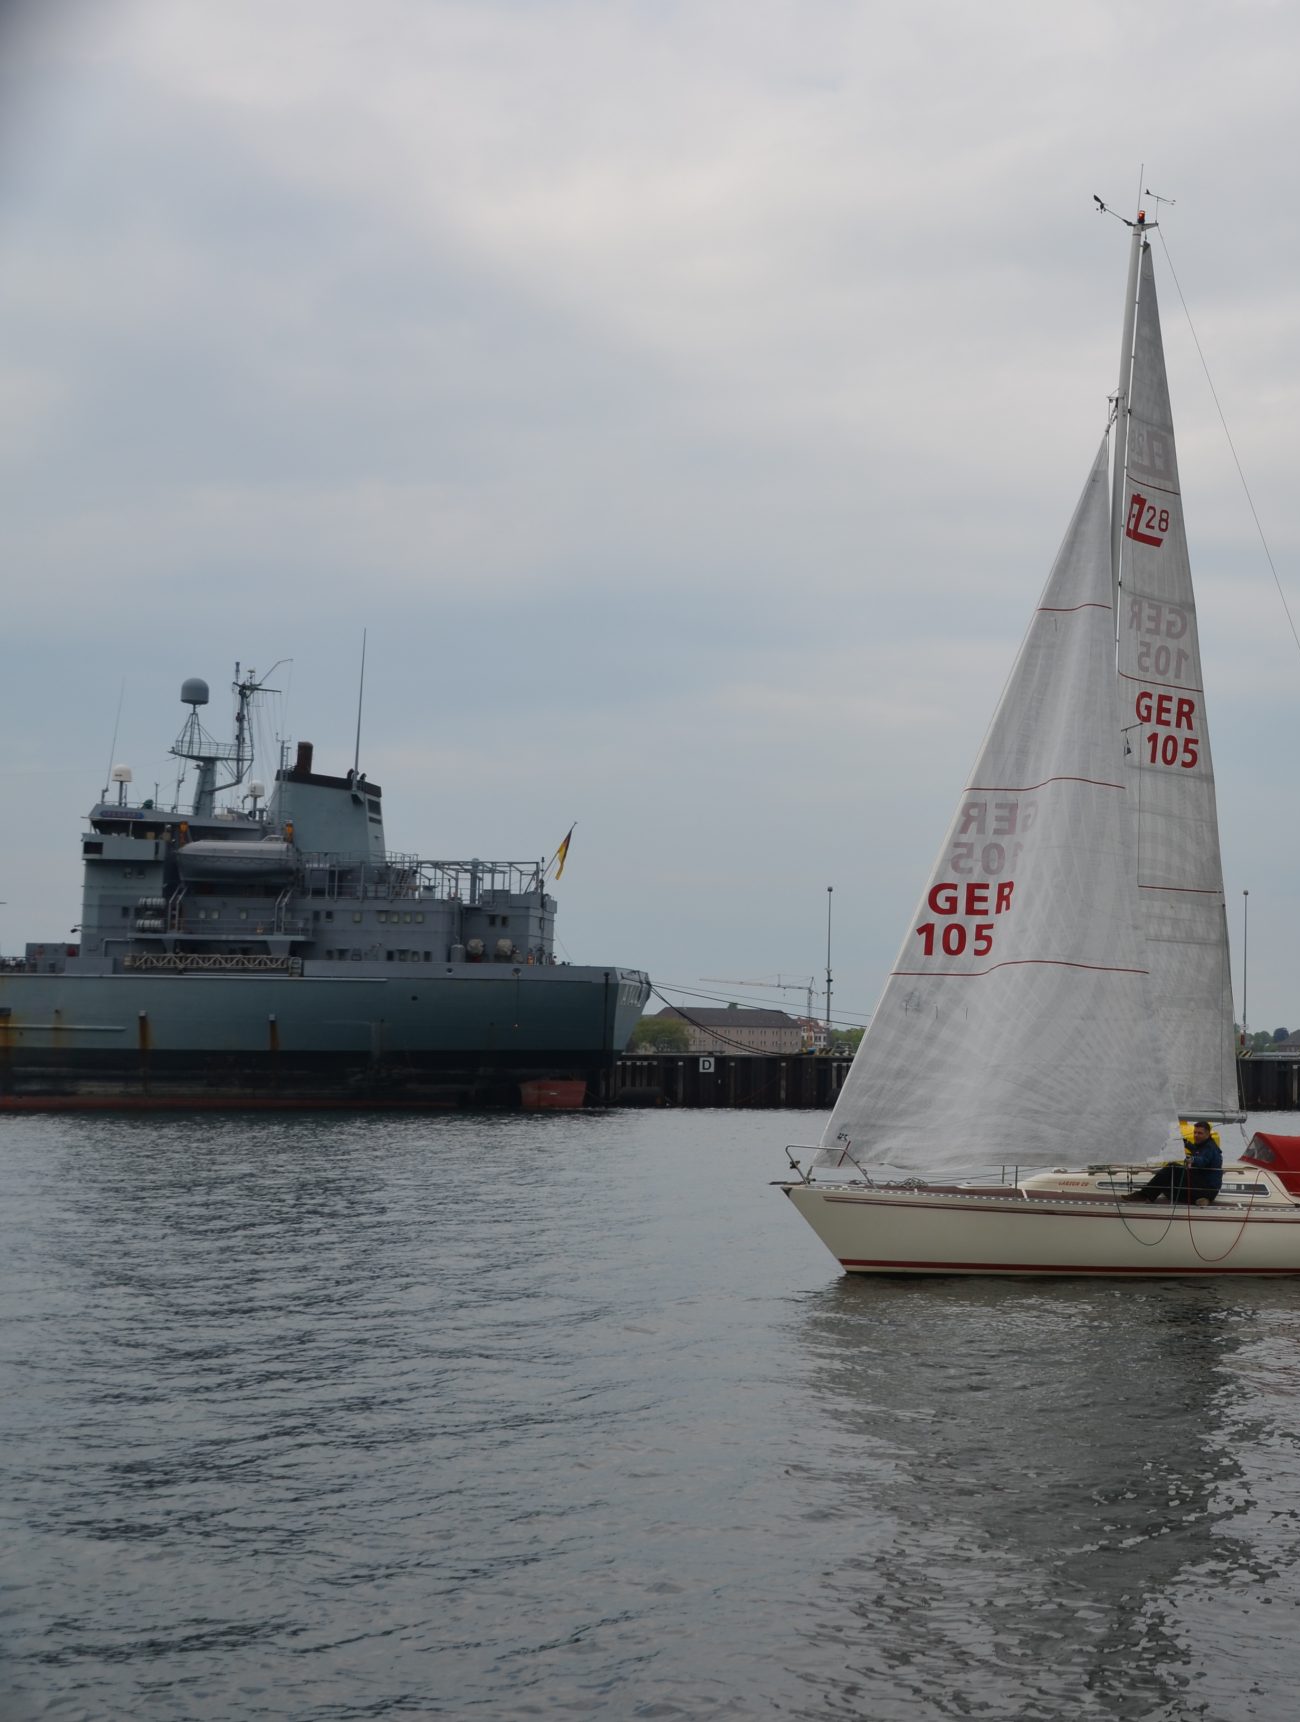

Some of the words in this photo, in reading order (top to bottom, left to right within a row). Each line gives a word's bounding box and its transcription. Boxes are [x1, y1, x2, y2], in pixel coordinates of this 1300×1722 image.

[1145, 505, 1170, 533] 28
[1135, 691, 1195, 731] GER
[1146, 732, 1199, 769] 105
[927, 880, 1014, 916] GER
[916, 922, 995, 957] 105
[702, 1059, 711, 1071] D
